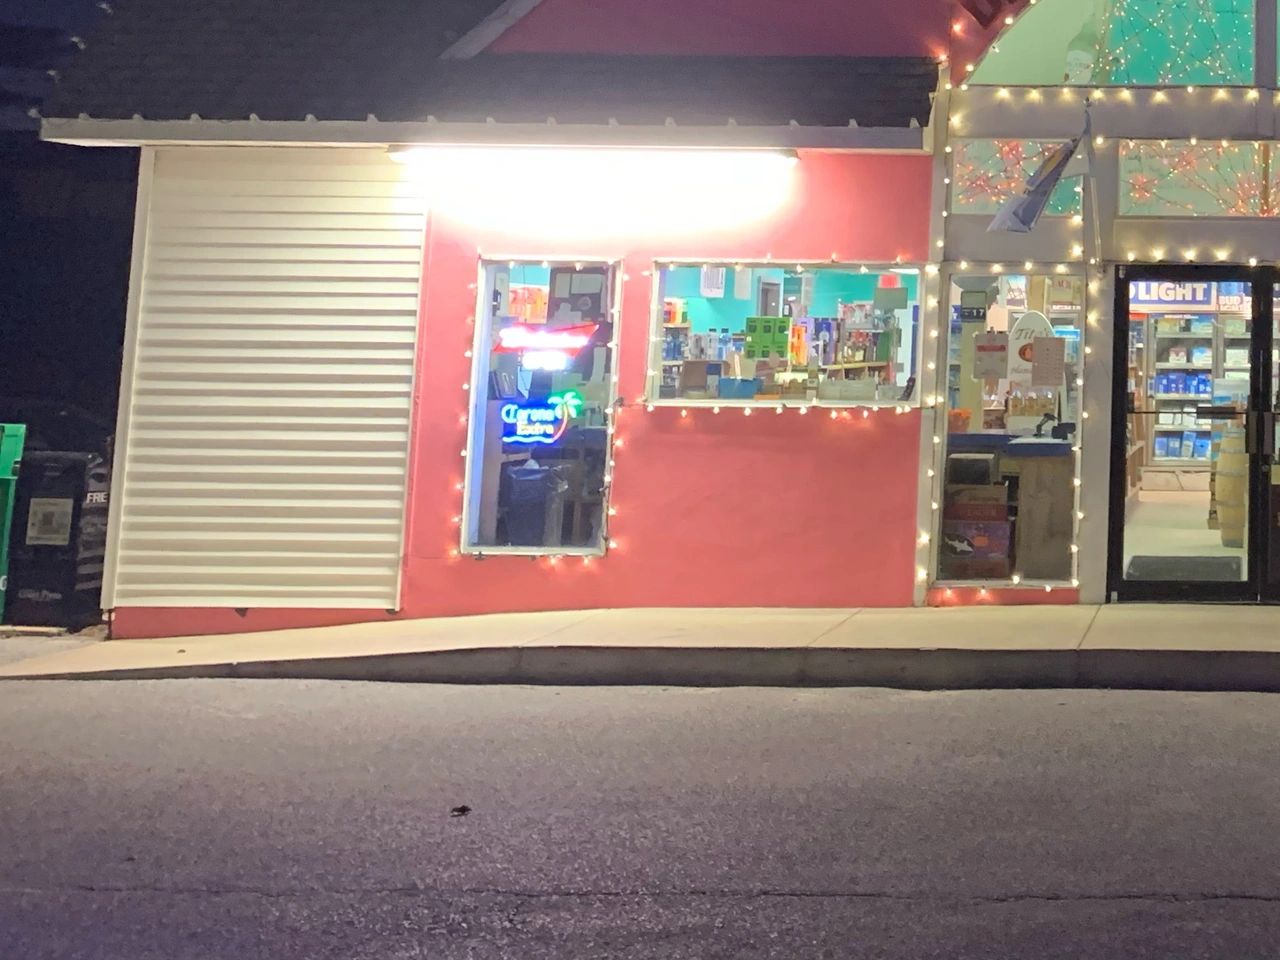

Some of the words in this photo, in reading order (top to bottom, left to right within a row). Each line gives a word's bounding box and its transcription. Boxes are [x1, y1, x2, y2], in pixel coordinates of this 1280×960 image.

[1137, 282, 1208, 301] LIGHT
[501, 404, 555, 425] Corona
[517, 422, 554, 436] Extra
